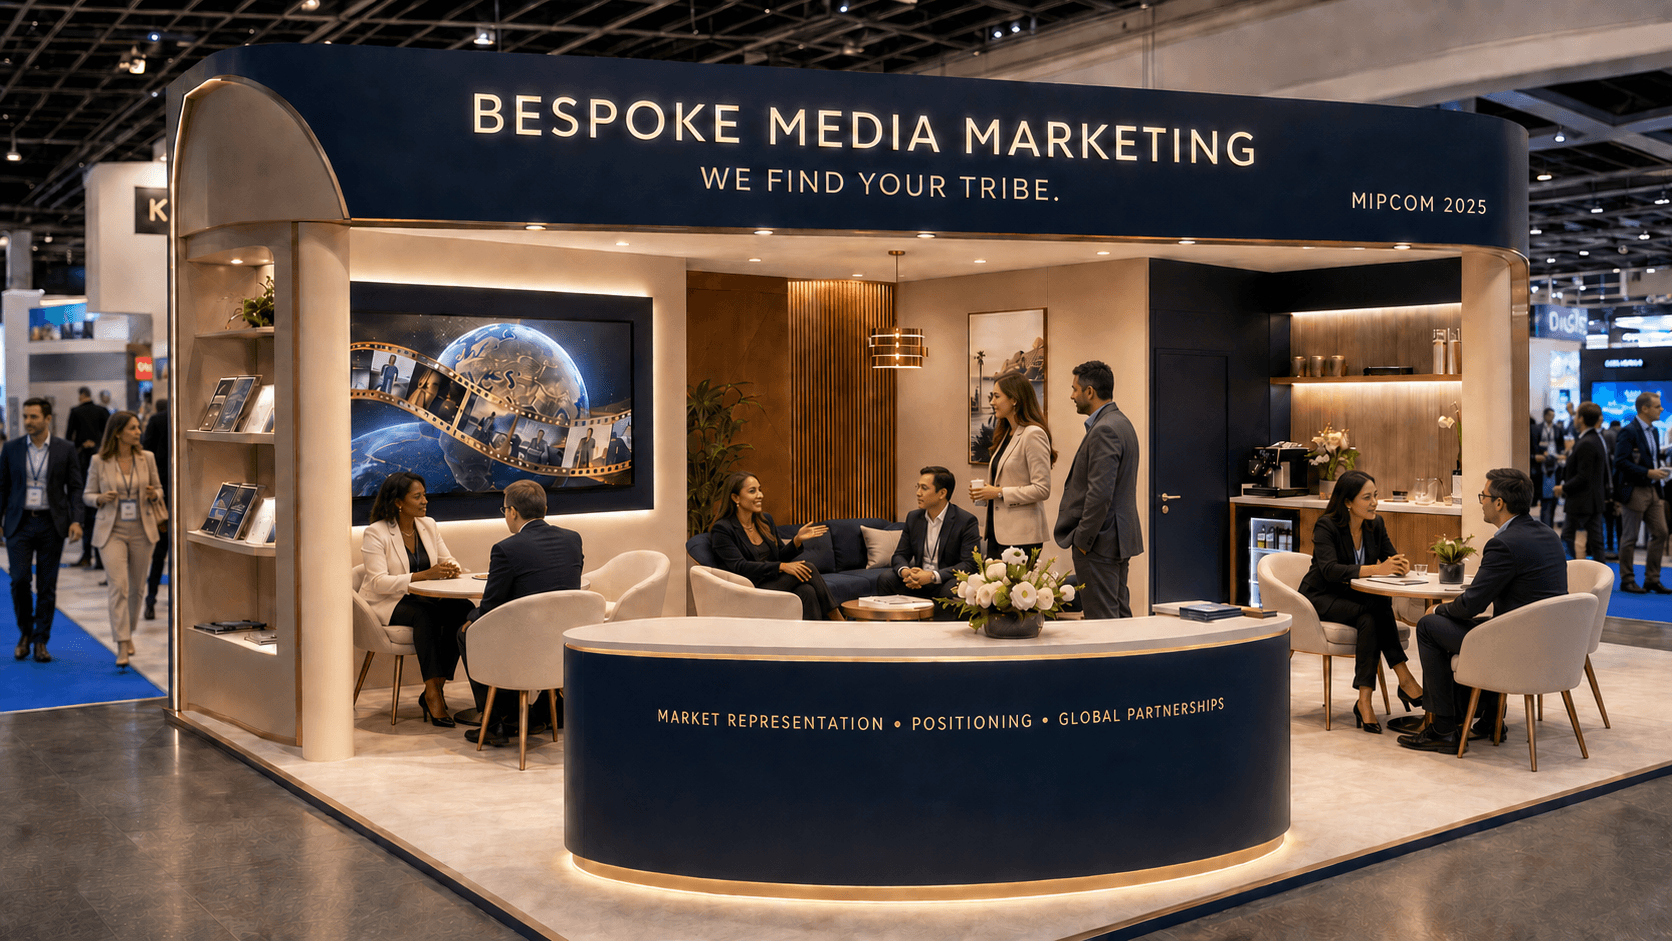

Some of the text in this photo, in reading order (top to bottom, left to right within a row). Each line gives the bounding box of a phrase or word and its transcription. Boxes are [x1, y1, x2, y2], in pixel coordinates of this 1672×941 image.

[473, 92, 1255, 167] BESPOKE MEDIA MARKETING
[700, 166, 1059, 202] WE FIND YOUR TRIBE.
[149, 198, 168, 222] K
[1352, 191, 1487, 215] MIPCOM 2025
[658, 697, 1225, 731] MARKET REPRESENTATION POSITIONING GLOBAL PARTNERSHIPS
